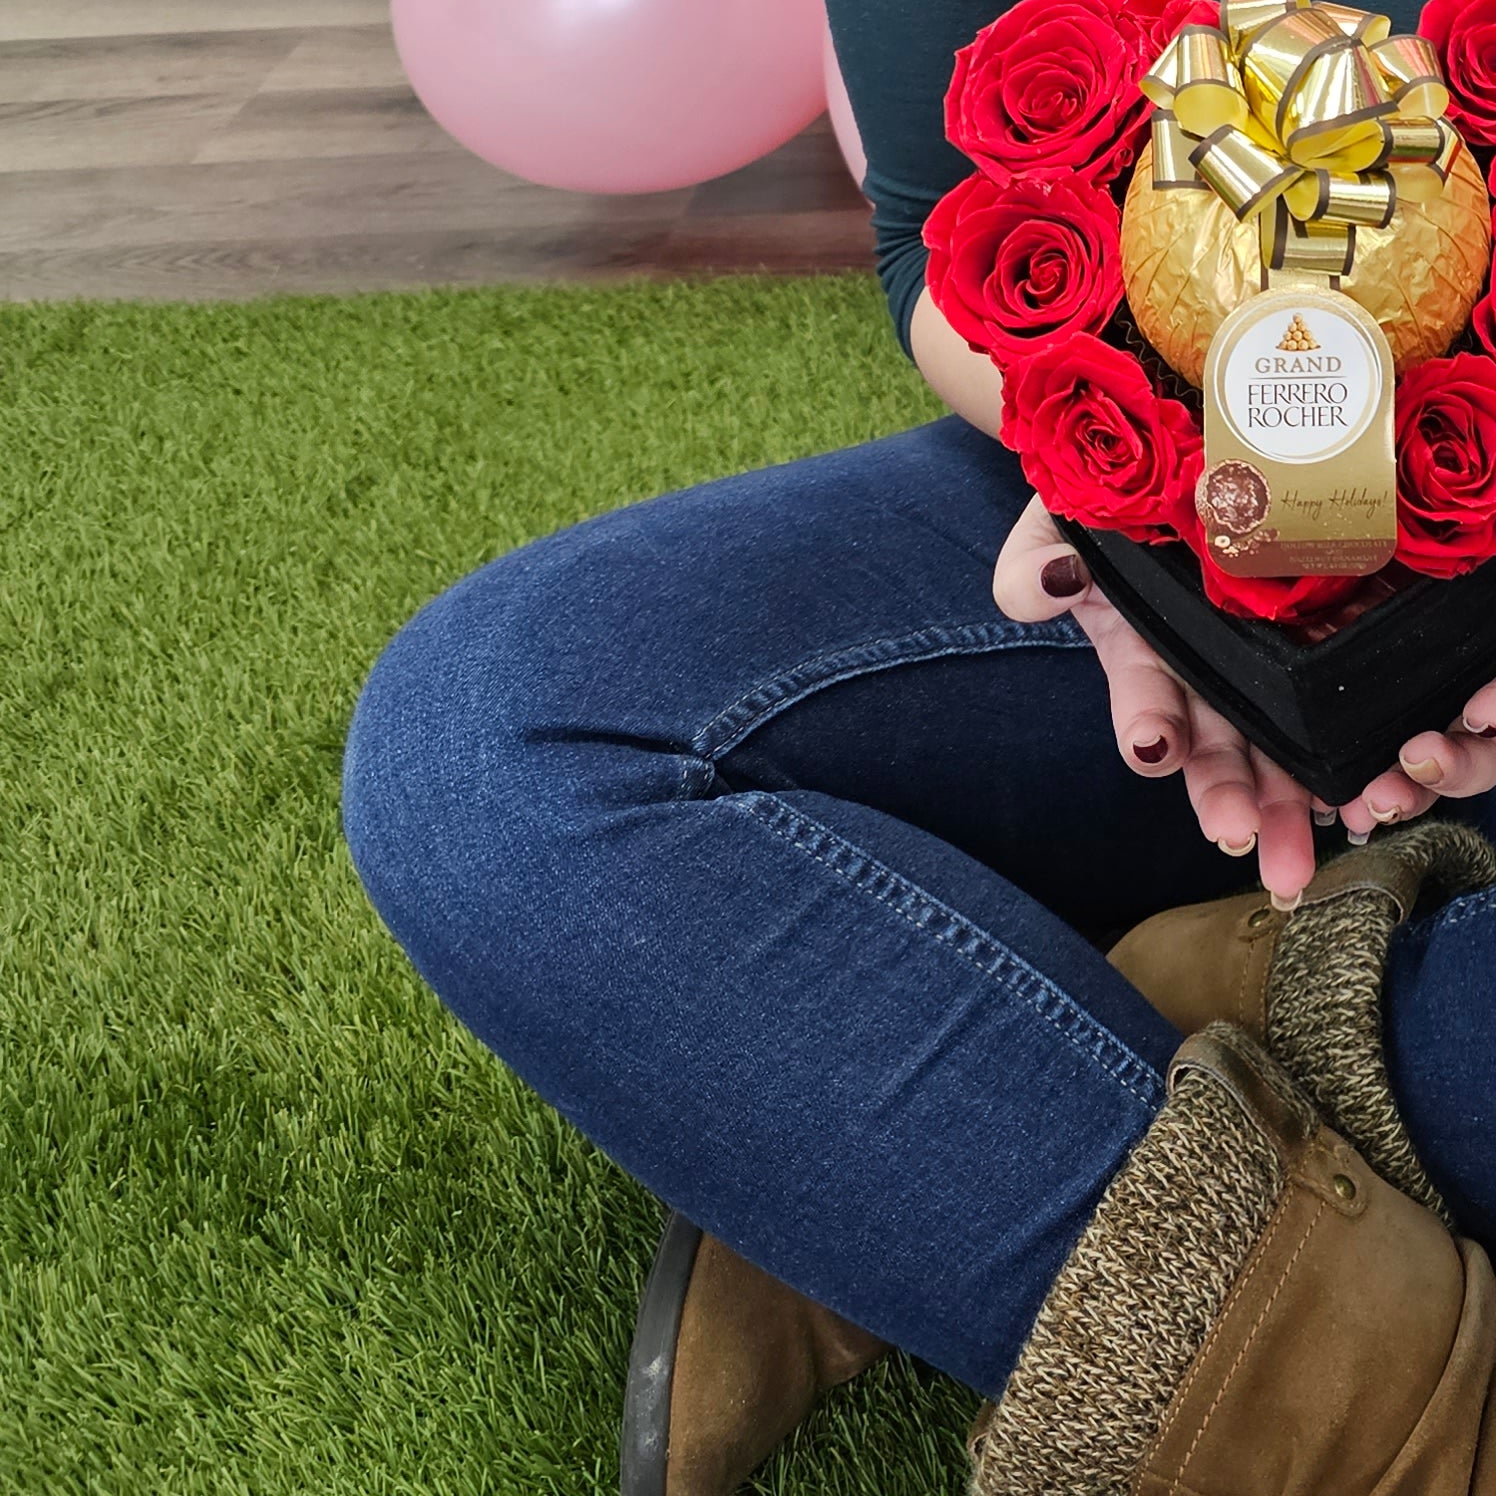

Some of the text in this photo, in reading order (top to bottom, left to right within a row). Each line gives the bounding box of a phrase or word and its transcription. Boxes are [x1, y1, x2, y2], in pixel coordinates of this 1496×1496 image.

[1255, 356, 1342, 374] GRAND
[1248, 383, 1348, 405] FERRERO
[1248, 406, 1349, 428] ROCHER
[1281, 487, 1388, 521] Happy Holidays!
